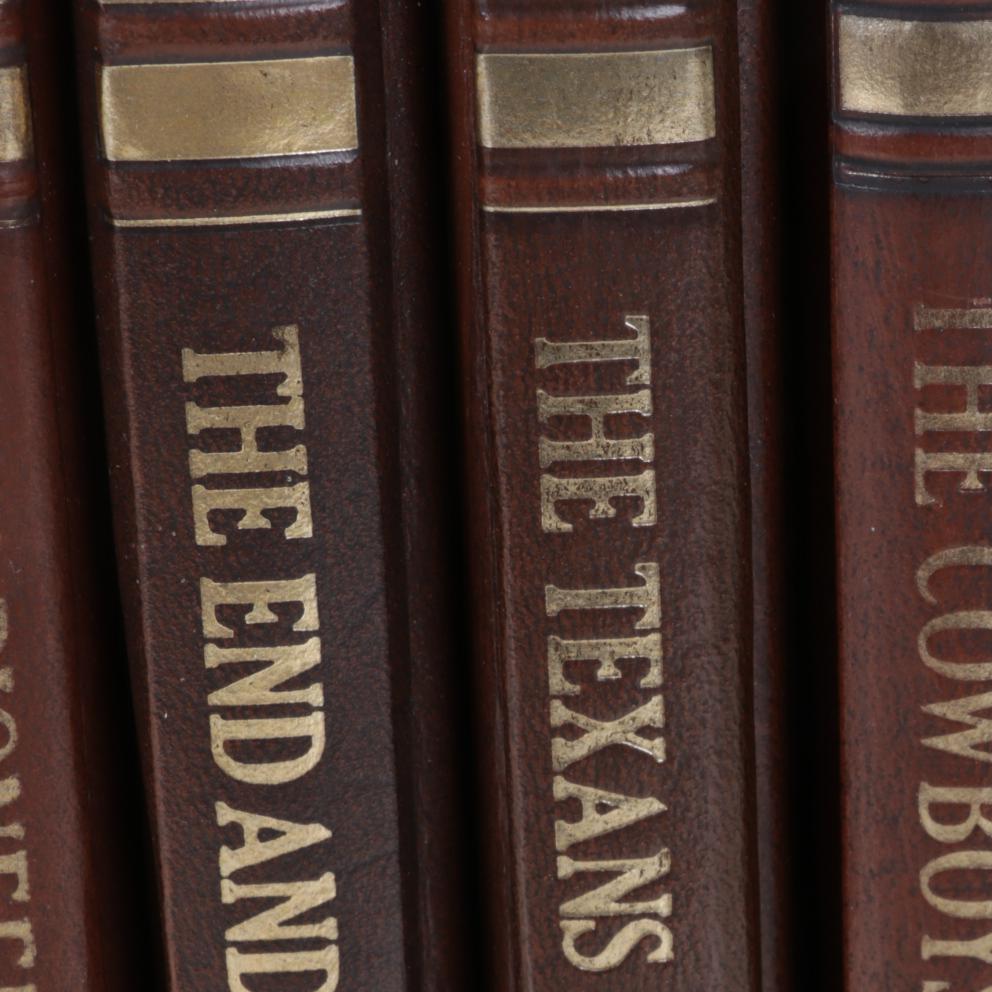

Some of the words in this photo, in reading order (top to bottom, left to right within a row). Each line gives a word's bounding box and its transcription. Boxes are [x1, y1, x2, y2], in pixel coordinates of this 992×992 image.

[182, 325, 313, 546] THE
[535, 314, 657, 532] THE
[200, 573, 326, 784] END
[545, 562, 674, 971] TEXANS
